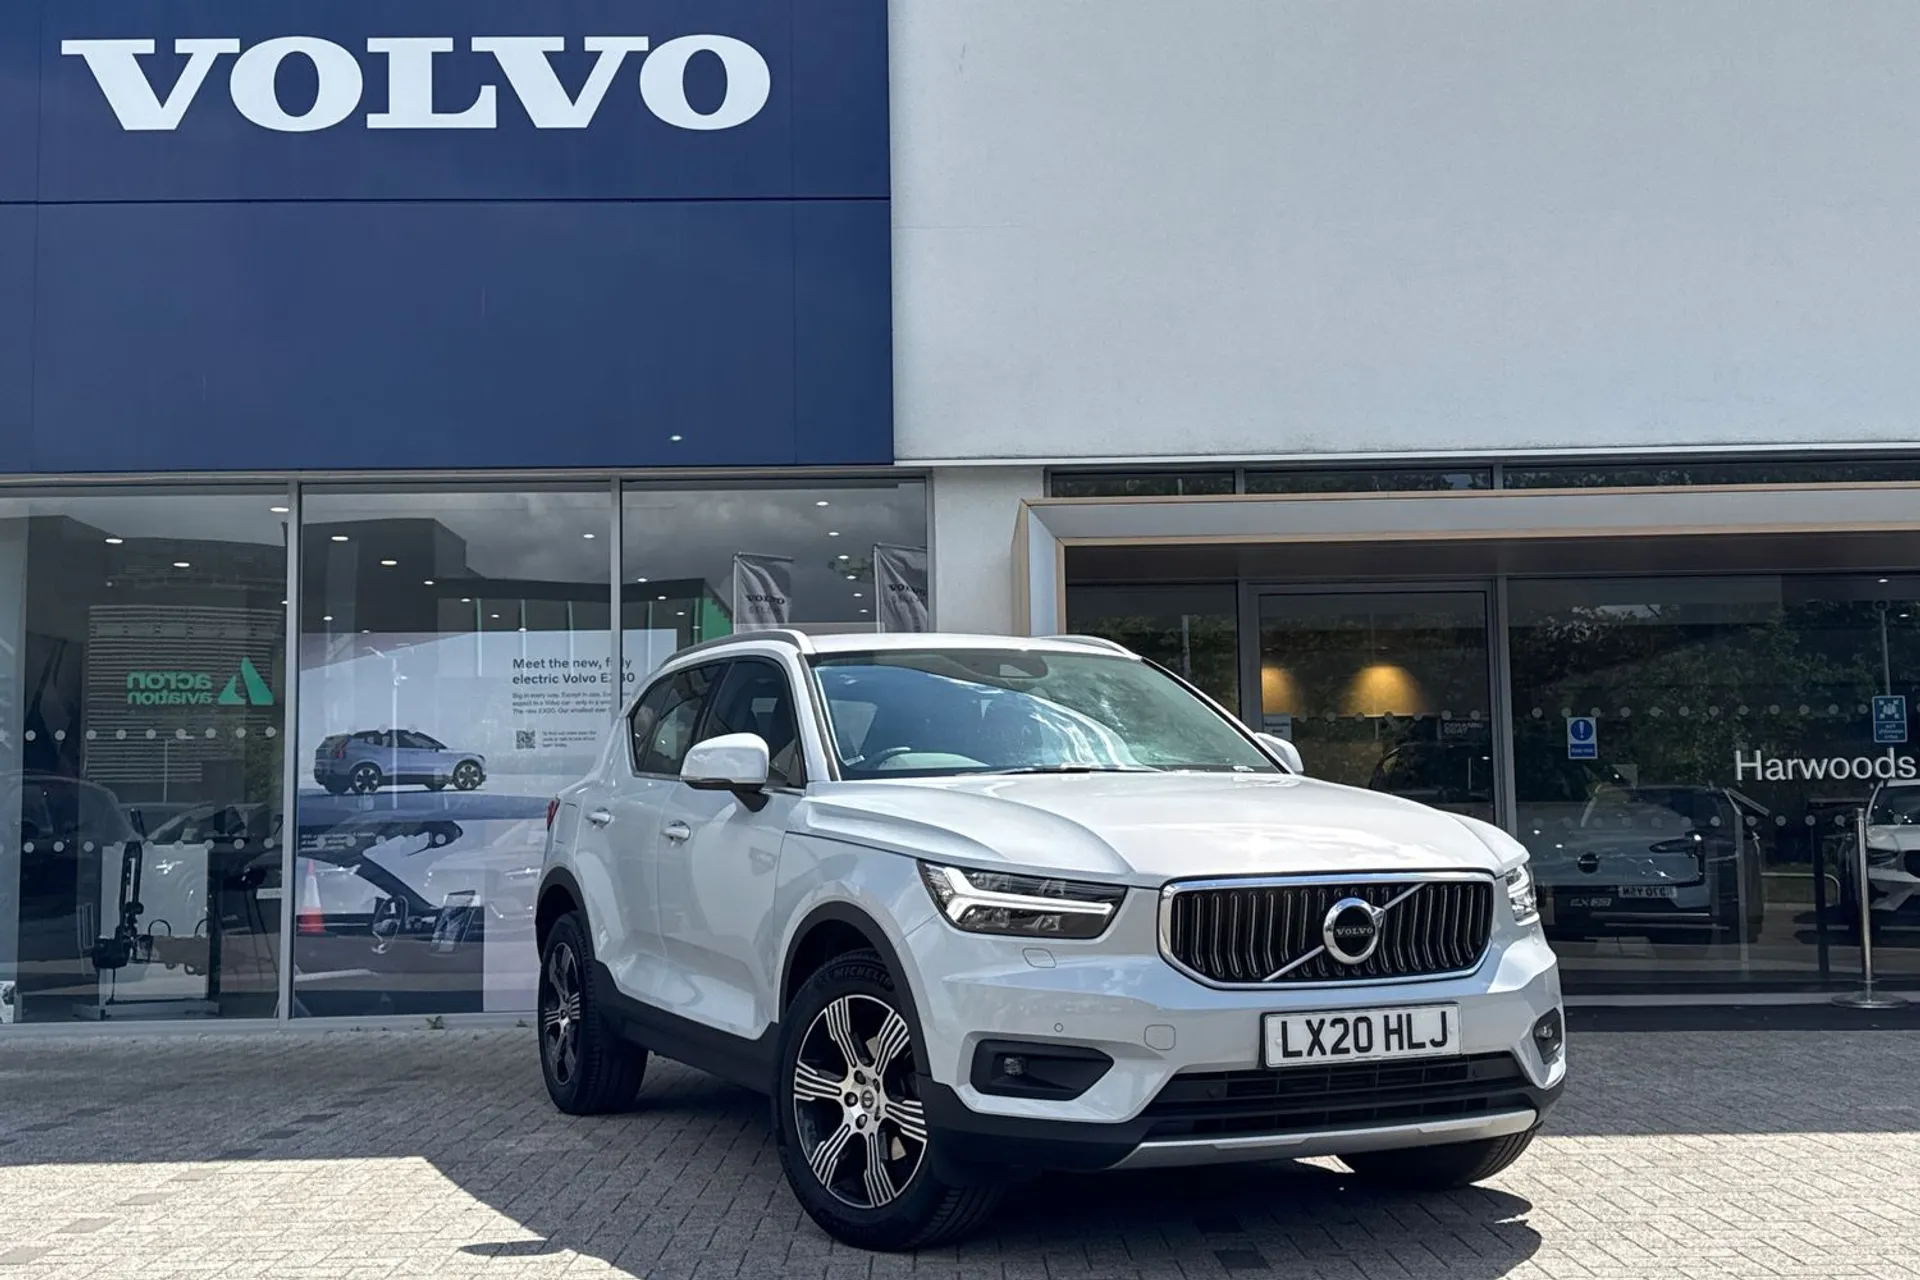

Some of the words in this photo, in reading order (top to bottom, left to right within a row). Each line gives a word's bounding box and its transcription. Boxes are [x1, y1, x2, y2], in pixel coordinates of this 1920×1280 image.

[62, 35, 770, 131] VOLVO
[512, 658, 546, 669] Meet
[548, 658, 570, 669] the
[572, 659, 602, 670] new,
[512, 673, 560, 684] electric
[562, 673, 597, 683] Volvo
[1735, 747, 1917, 781] Harwoods
[1336, 926, 1374, 936] VOLVO
[1280, 1016, 1374, 1059] LX20
[1383, 1010, 1448, 1052] HLJ
